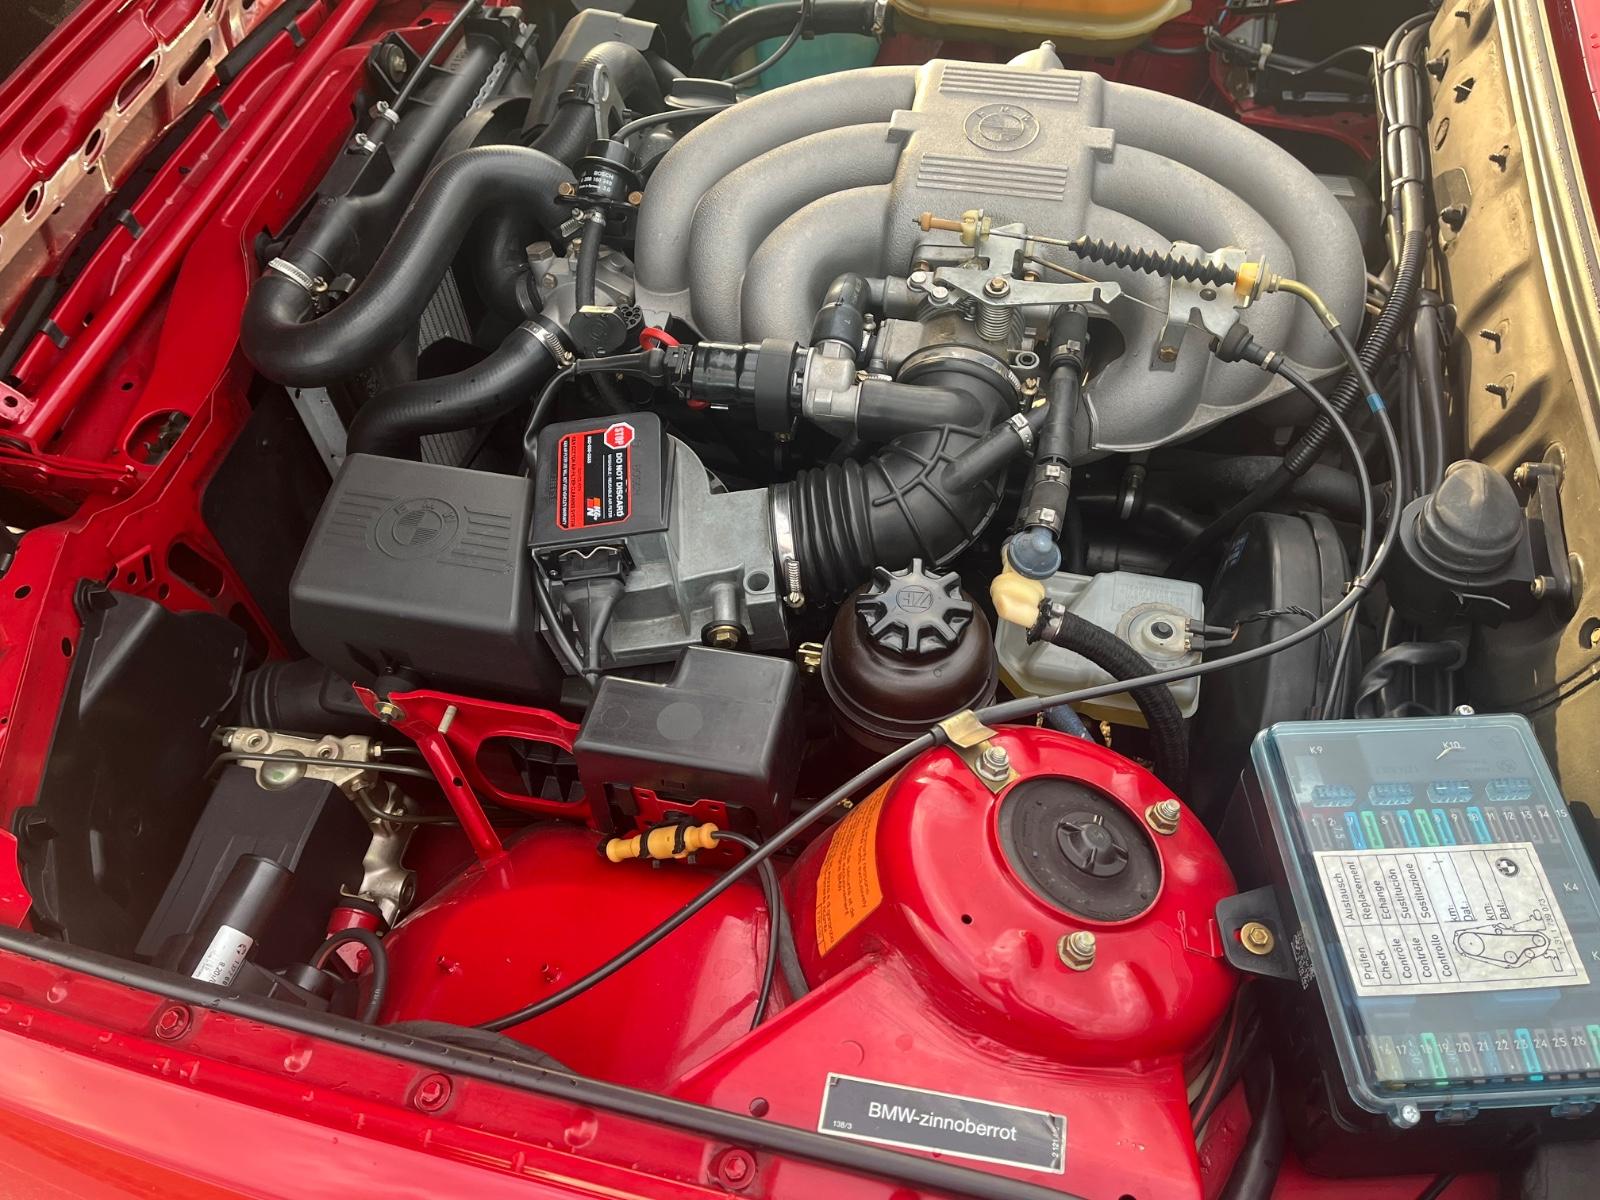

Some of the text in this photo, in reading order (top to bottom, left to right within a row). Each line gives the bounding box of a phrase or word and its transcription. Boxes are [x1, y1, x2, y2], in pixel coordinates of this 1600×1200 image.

[594, 170, 614, 180] BOSCH
[614, 426, 624, 445] STOP
[616, 452, 622, 464] DO
[616, 481, 624, 517] DISCARD
[1310, 745, 1324, 754] K9
[1328, 818, 1336, 826] 2
[1380, 816, 1388, 824] 5
[1451, 813, 1458, 822] 9
[1504, 812, 1515, 821] 12
[1520, 810, 1532, 820] 13
[1538, 810, 1550, 819] 14
[1556, 810, 1568, 818] 15
[1334, 872, 1355, 920] Austausch
[1347, 862, 1372, 920] Replacement
[1374, 880, 1392, 920] Echange
[1389, 868, 1411, 919] Sustitución
[1406, 863, 1431, 918] Sostituzione
[1563, 882, 1579, 891] K4
[1448, 904, 1458, 921] km:
[1485, 903, 1496, 920] km:
[1376, 950, 1392, 980] Check
[1392, 938, 1412, 978] Contrôle
[1432, 934, 1452, 977] Controllo
[1396, 1045, 1407, 1054] 17
[1420, 1044, 1432, 1054] 18
[1456, 1042, 1470, 1053] 20
[1478, 1041, 1490, 1052] 21
[1496, 1040, 1510, 1050] 22
[1514, 1039, 1528, 1050] 23
[1534, 1038, 1548, 1048] 24
[1552, 1037, 1568, 1048] 25
[868, 1101, 1017, 1142] BMW-zinnoberrot
